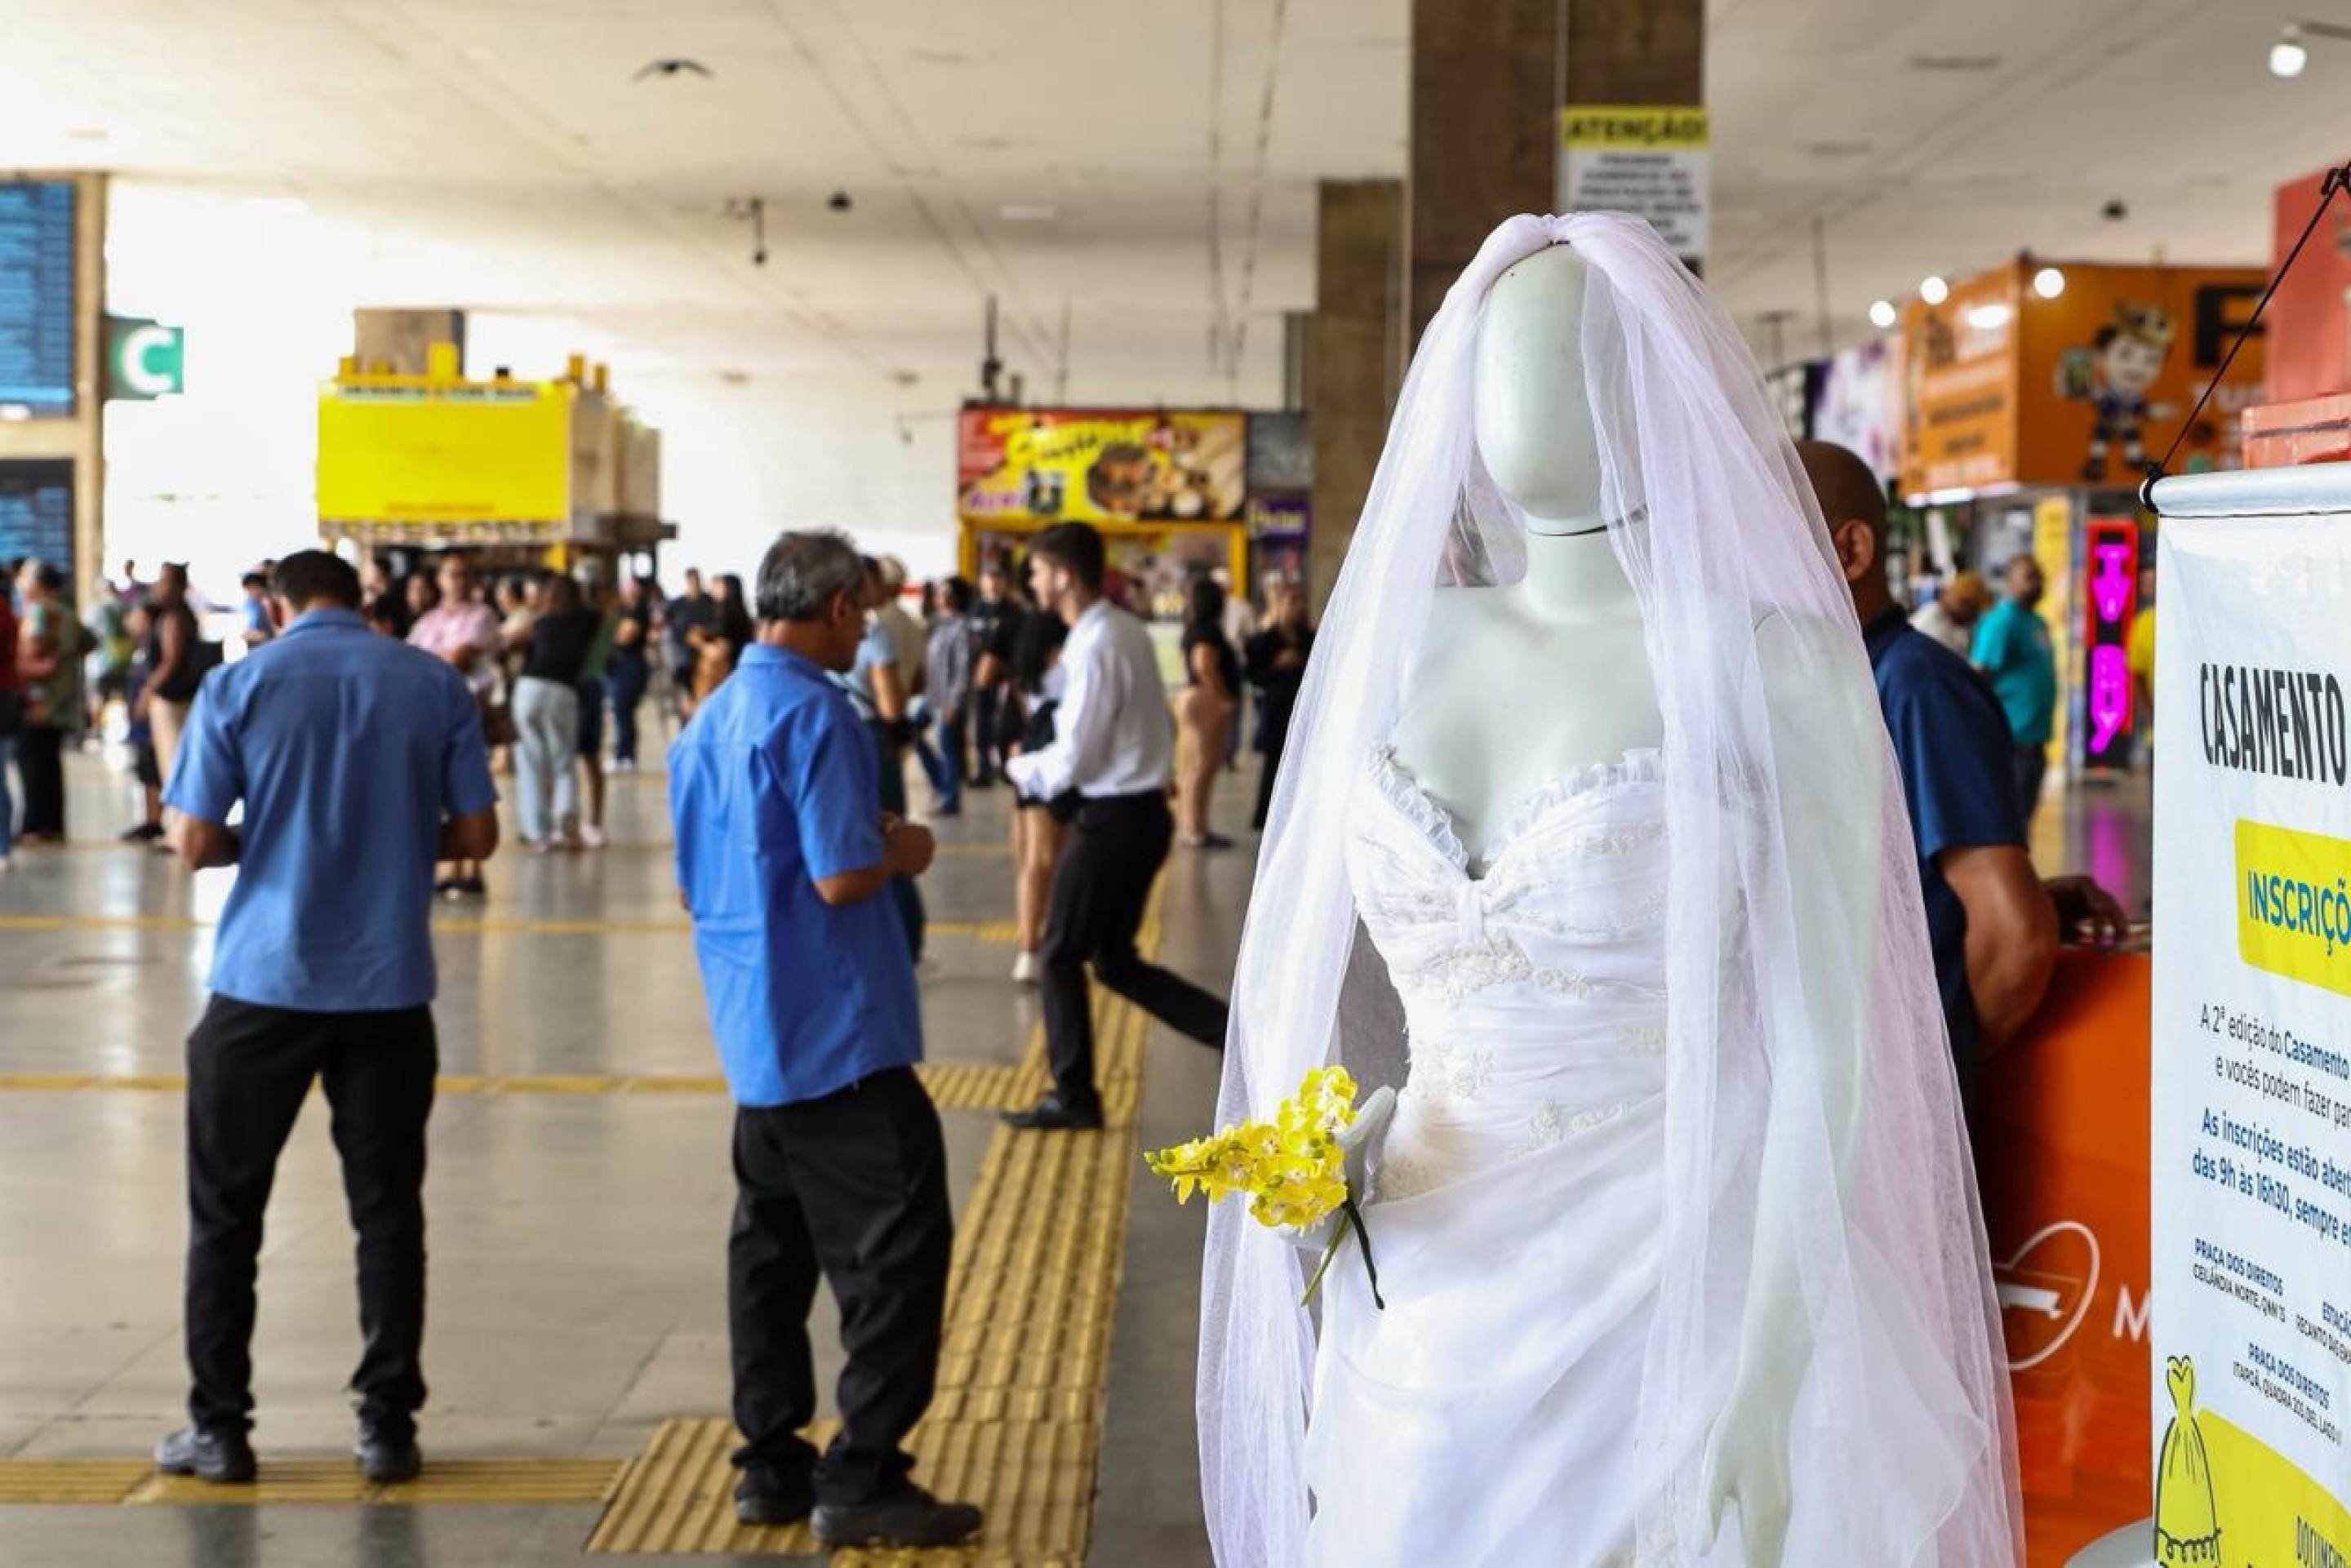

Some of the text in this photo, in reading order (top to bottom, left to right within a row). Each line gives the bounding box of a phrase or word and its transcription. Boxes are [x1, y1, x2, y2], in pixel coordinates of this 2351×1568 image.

[122, 326, 176, 394] C
[2201, 662, 2346, 786] CASAMENTO
[2201, 1002, 2210, 1030] A
[2228, 1013, 2266, 1051] edição
[2269, 1024, 2282, 1054] do
[2285, 1030, 2350, 1080] Casamento
[2215, 1056, 2223, 1077] e
[2226, 1059, 2260, 1090] vocês
[2262, 1071, 2300, 1108] podem
[2304, 1081, 2331, 1118] fazer
[2202, 1107, 2219, 1137] As
[2222, 1111, 2284, 1165] inscrições
[2287, 1146, 2318, 1180] estão
[2193, 1147, 2216, 1181] das
[2220, 1157, 2235, 1189] 9h
[2239, 1163, 2253, 1196] às
[2257, 1170, 2292, 1222] 16h30,
[2295, 1197, 2339, 1240] sempre
[2194, 1237, 2283, 1297] PRAÇA DOS DIREITOS
[2248, 1342, 2330, 1410] PRAÇA DOS DIREITOS
